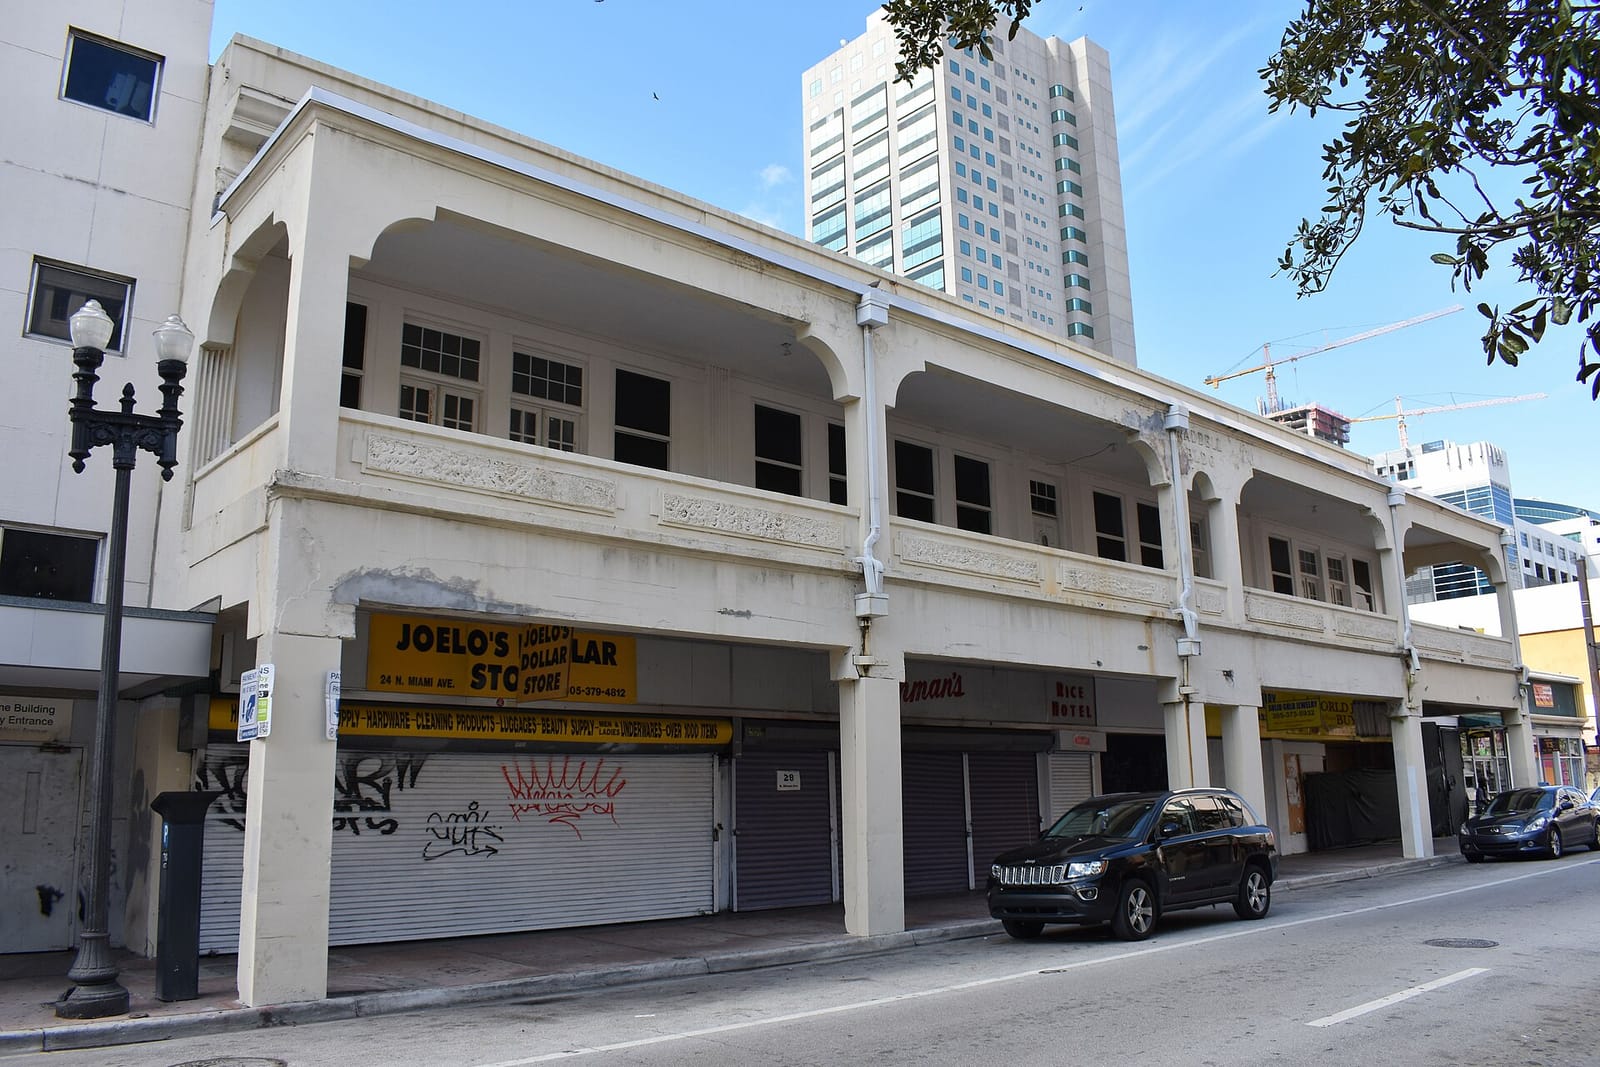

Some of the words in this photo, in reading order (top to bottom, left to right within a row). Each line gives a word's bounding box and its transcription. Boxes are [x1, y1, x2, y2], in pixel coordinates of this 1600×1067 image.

[396, 624, 510, 657] JOELO'S
[523, 624, 569, 648] JOELO'S
[520, 646, 567, 671] DOLLAR
[571, 639, 618, 666] LAR
[380, 675, 392, 685] 24
[395, 676, 405, 686] N.
[408, 677, 434, 688] MIAMI
[437, 680, 455, 689] AVE.
[470, 663, 519, 692] STO
[523, 672, 562, 695] STORE
[569, 686, 626, 697] 05-379-4812
[901, 672, 965, 703] nman's
[0, 704, 11, 712] ne
[14, 703, 56, 716] Building
[1320, 701, 1349, 713] ORLD
[8, 715, 54, 726] Entrance
[599, 728, 620, 736] LADIES
[783, 773, 794, 782] 28
